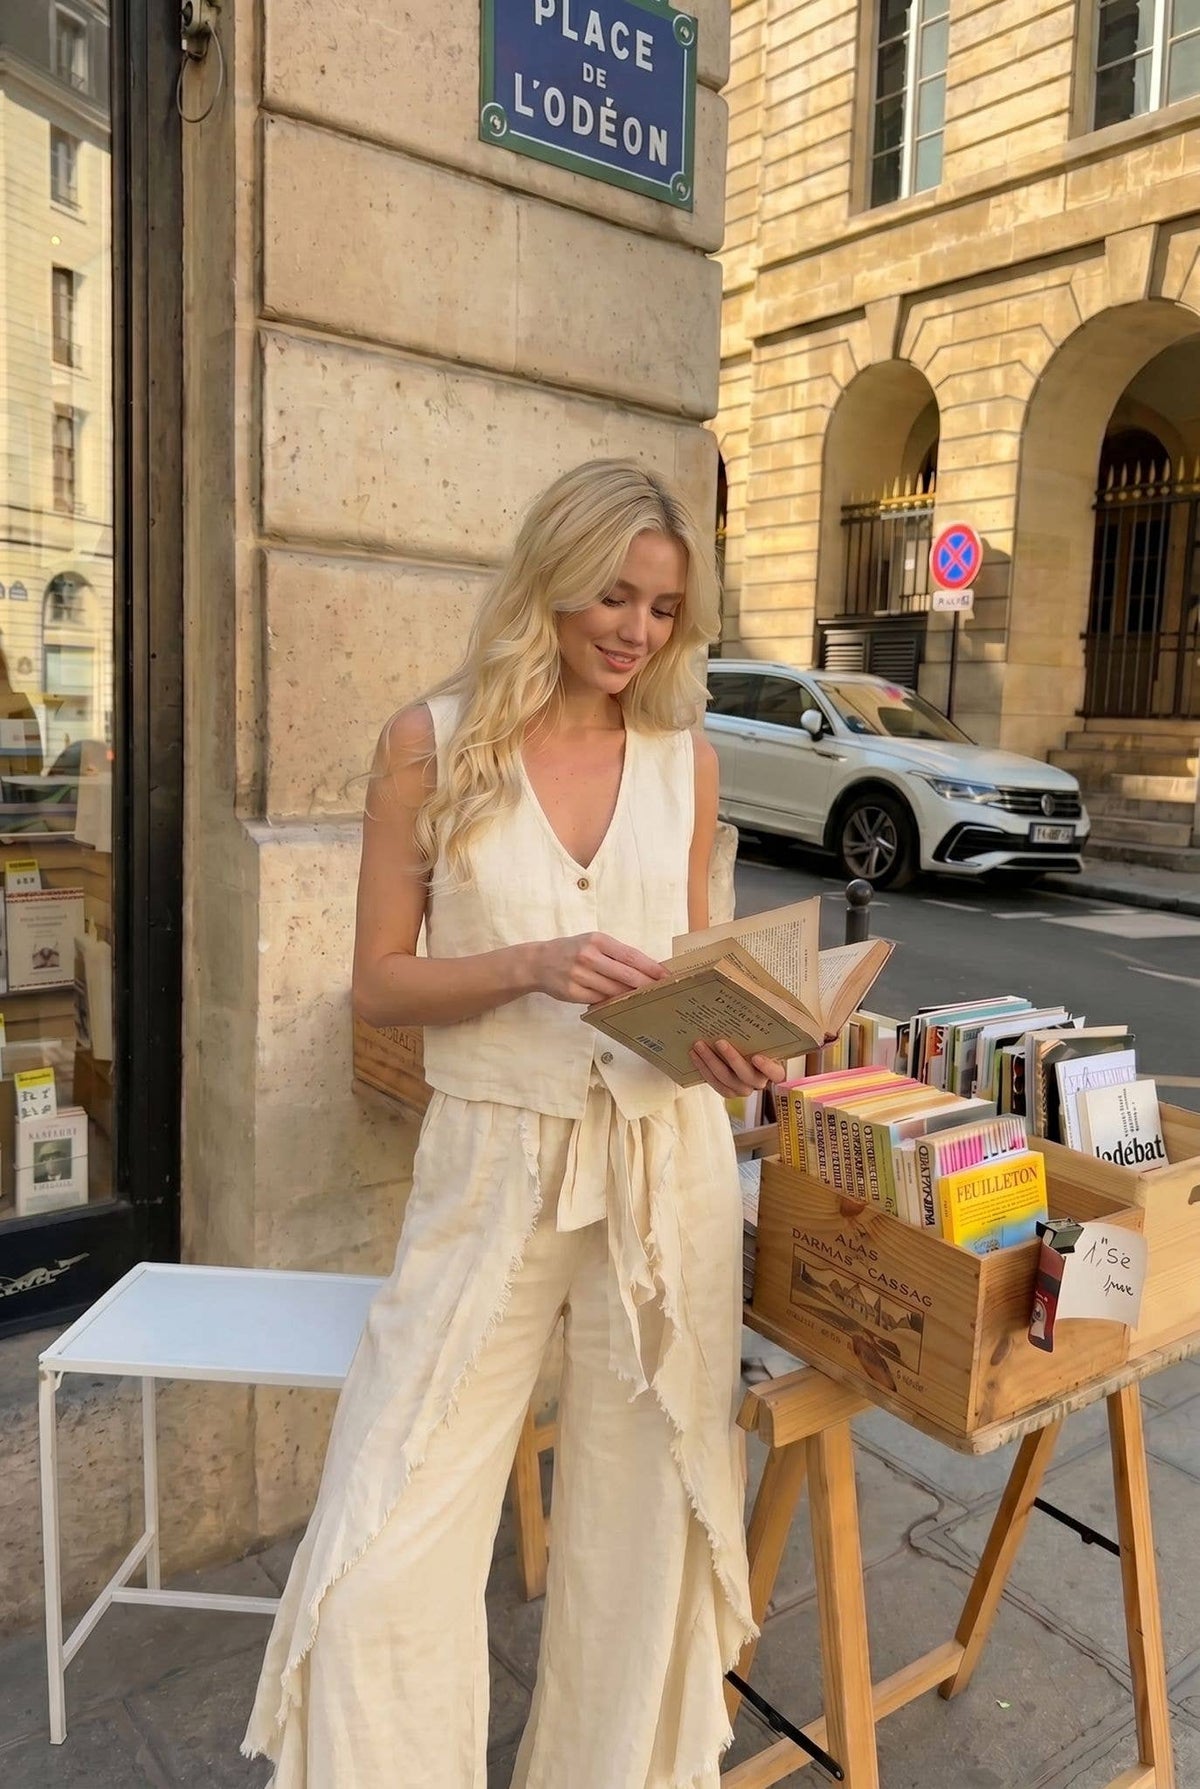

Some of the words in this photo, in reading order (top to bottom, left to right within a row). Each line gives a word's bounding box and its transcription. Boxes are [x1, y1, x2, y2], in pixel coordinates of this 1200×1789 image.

[534, 0, 654, 72] PLACE
[582, 62, 607, 89] DE
[514, 72, 668, 166] L'ODÉON
[957, 1166, 1038, 1203] FEUILLETON
[791, 1227, 854, 1267] DARMAS
